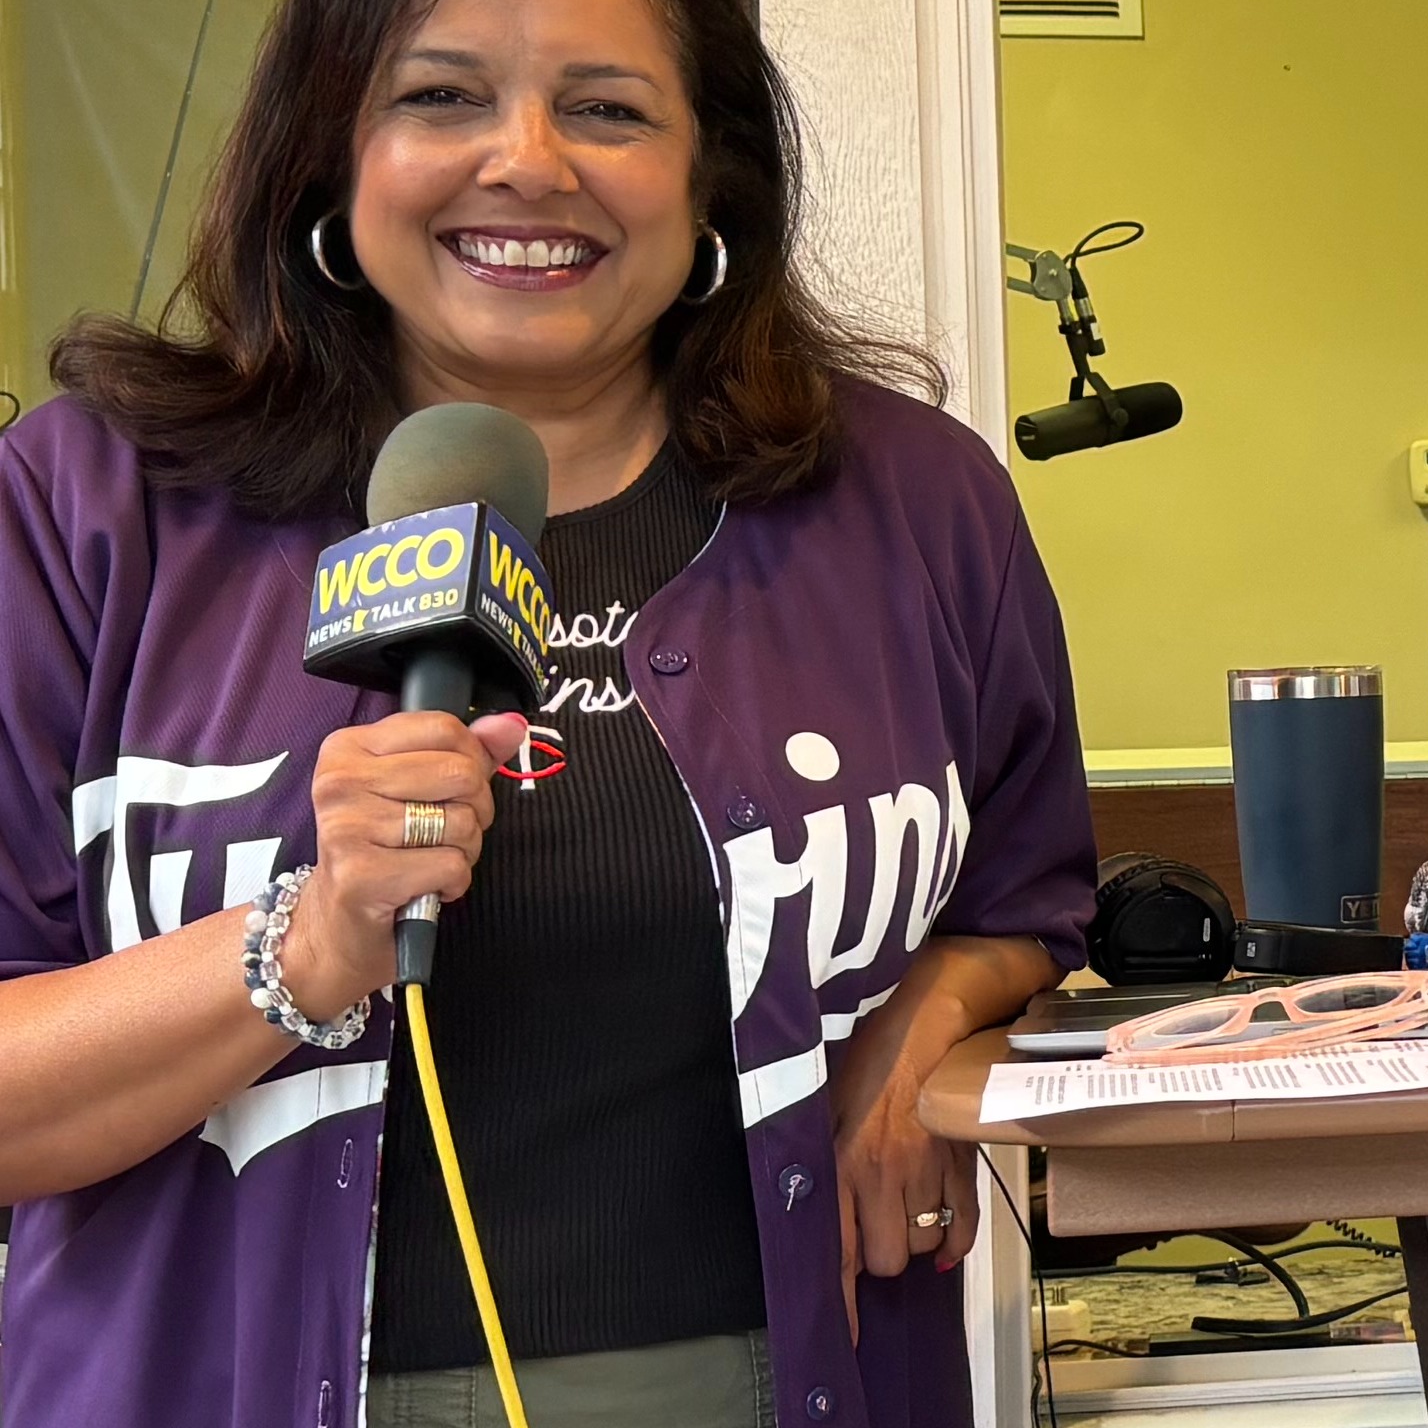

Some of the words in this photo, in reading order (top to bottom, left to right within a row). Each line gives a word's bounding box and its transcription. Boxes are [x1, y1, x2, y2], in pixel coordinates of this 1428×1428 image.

[318, 528, 465, 615] WCCO
[488, 529, 551, 657] WCCO
[308, 616, 353, 648] NEWS
[371, 595, 417, 622] TALK
[418, 587, 459, 611] 830
[481, 592, 513, 636] NEWS
